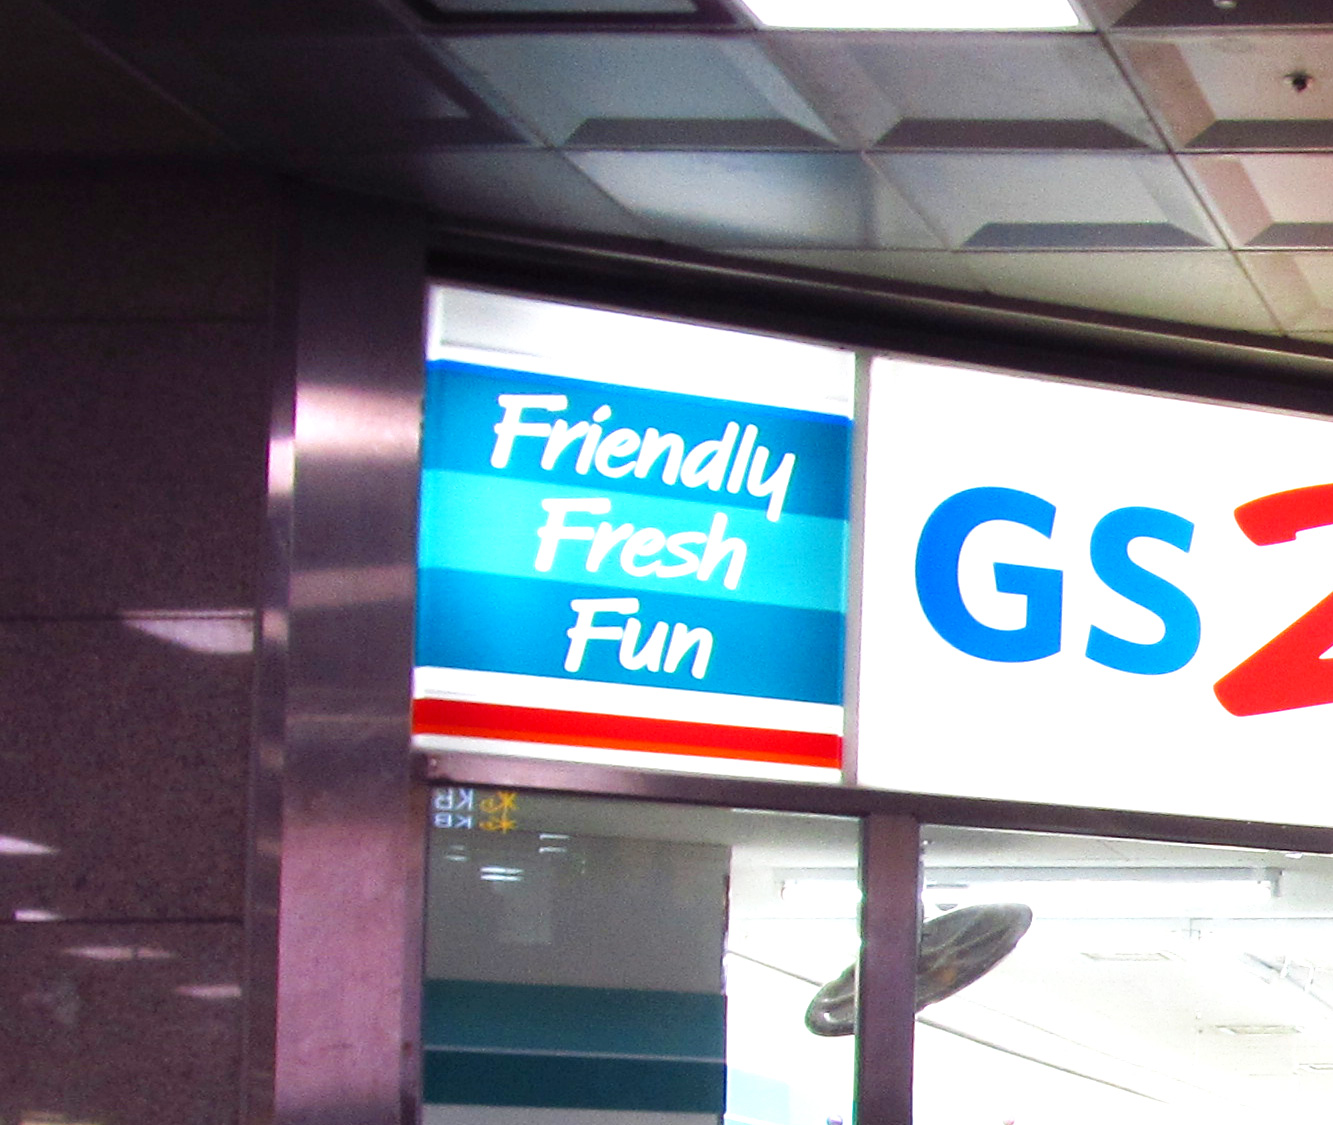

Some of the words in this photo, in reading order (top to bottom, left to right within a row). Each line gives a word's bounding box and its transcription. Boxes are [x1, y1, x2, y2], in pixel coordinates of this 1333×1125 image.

[490, 392, 797, 522] Friendly
[533, 496, 749, 590] Fresh
[563, 597, 714, 679] Fun
